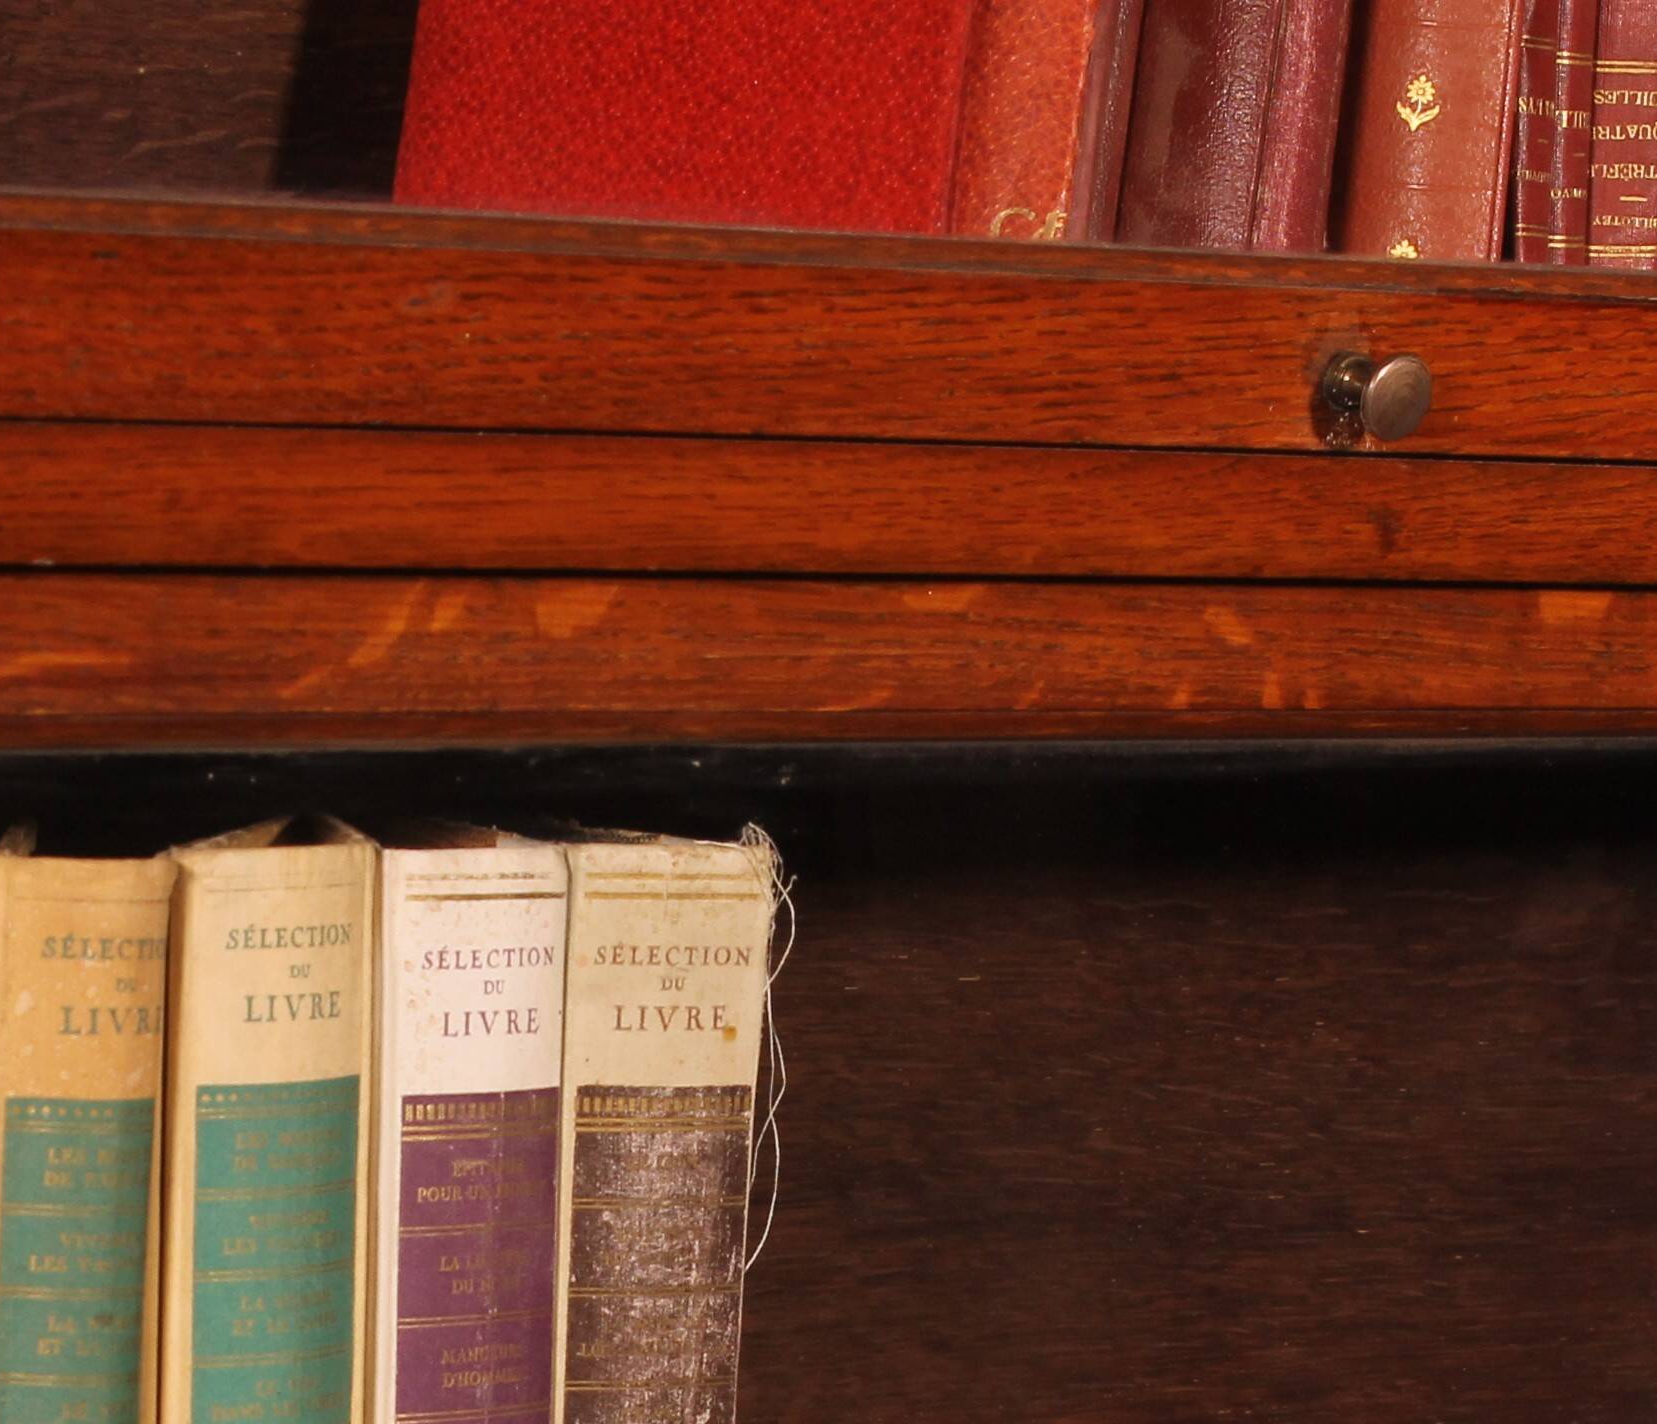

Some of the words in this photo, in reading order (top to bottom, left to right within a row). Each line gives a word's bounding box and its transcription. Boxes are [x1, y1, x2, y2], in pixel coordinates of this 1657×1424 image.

[1594, 89, 1657, 106] UILLES
[41, 932, 167, 961] SÉLECTIO
[227, 920, 352, 950] SÉLECTION
[422, 945, 555, 969] SÉLECTION
[594, 942, 752, 967] SÉLECTION
[290, 964, 311, 979] DU
[483, 980, 505, 994] DU
[660, 976, 686, 992] DU
[244, 990, 341, 1023] LIVRE
[614, 1005, 727, 1032] LIVRE
[442, 1008, 540, 1037] LIVRE
[417, 1185, 463, 1203] POUR
[439, 1256, 460, 1272] LA
